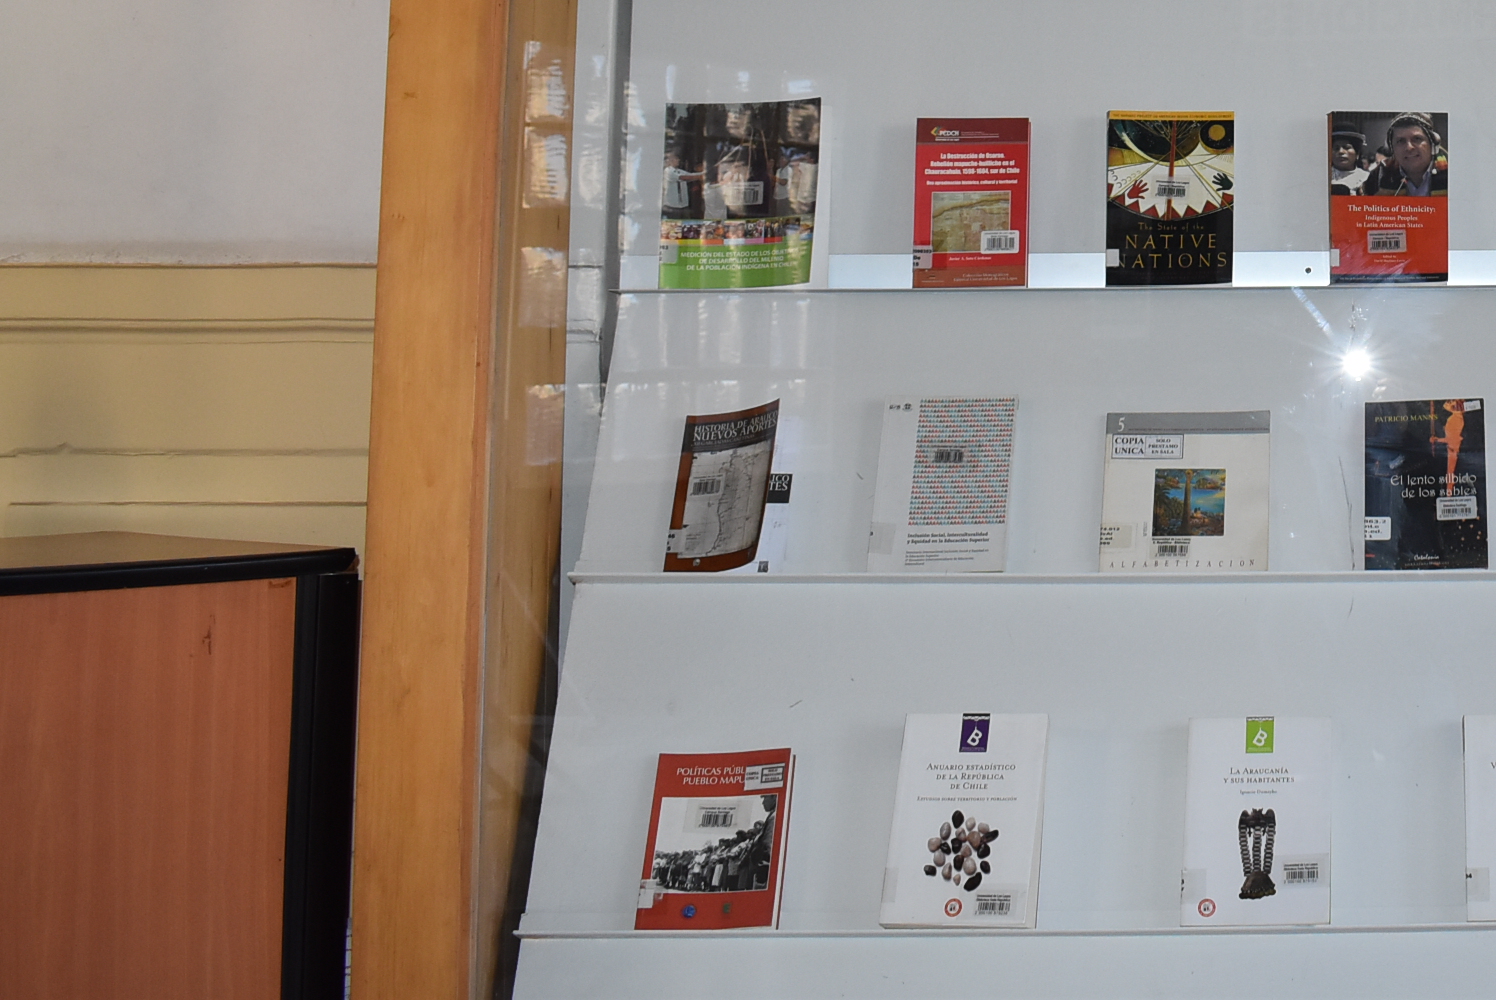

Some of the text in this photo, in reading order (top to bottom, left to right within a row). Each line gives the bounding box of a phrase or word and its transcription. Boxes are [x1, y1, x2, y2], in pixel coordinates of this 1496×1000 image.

[1401, 205, 1436, 214] Ethnicity:
[1125, 233, 1217, 249] NATIVE
[1118, 417, 1126, 432] 5
[1407, 474, 1436, 486] lento
[1438, 473, 1477, 484] silbido
[1402, 486, 1477, 498] de los sables
